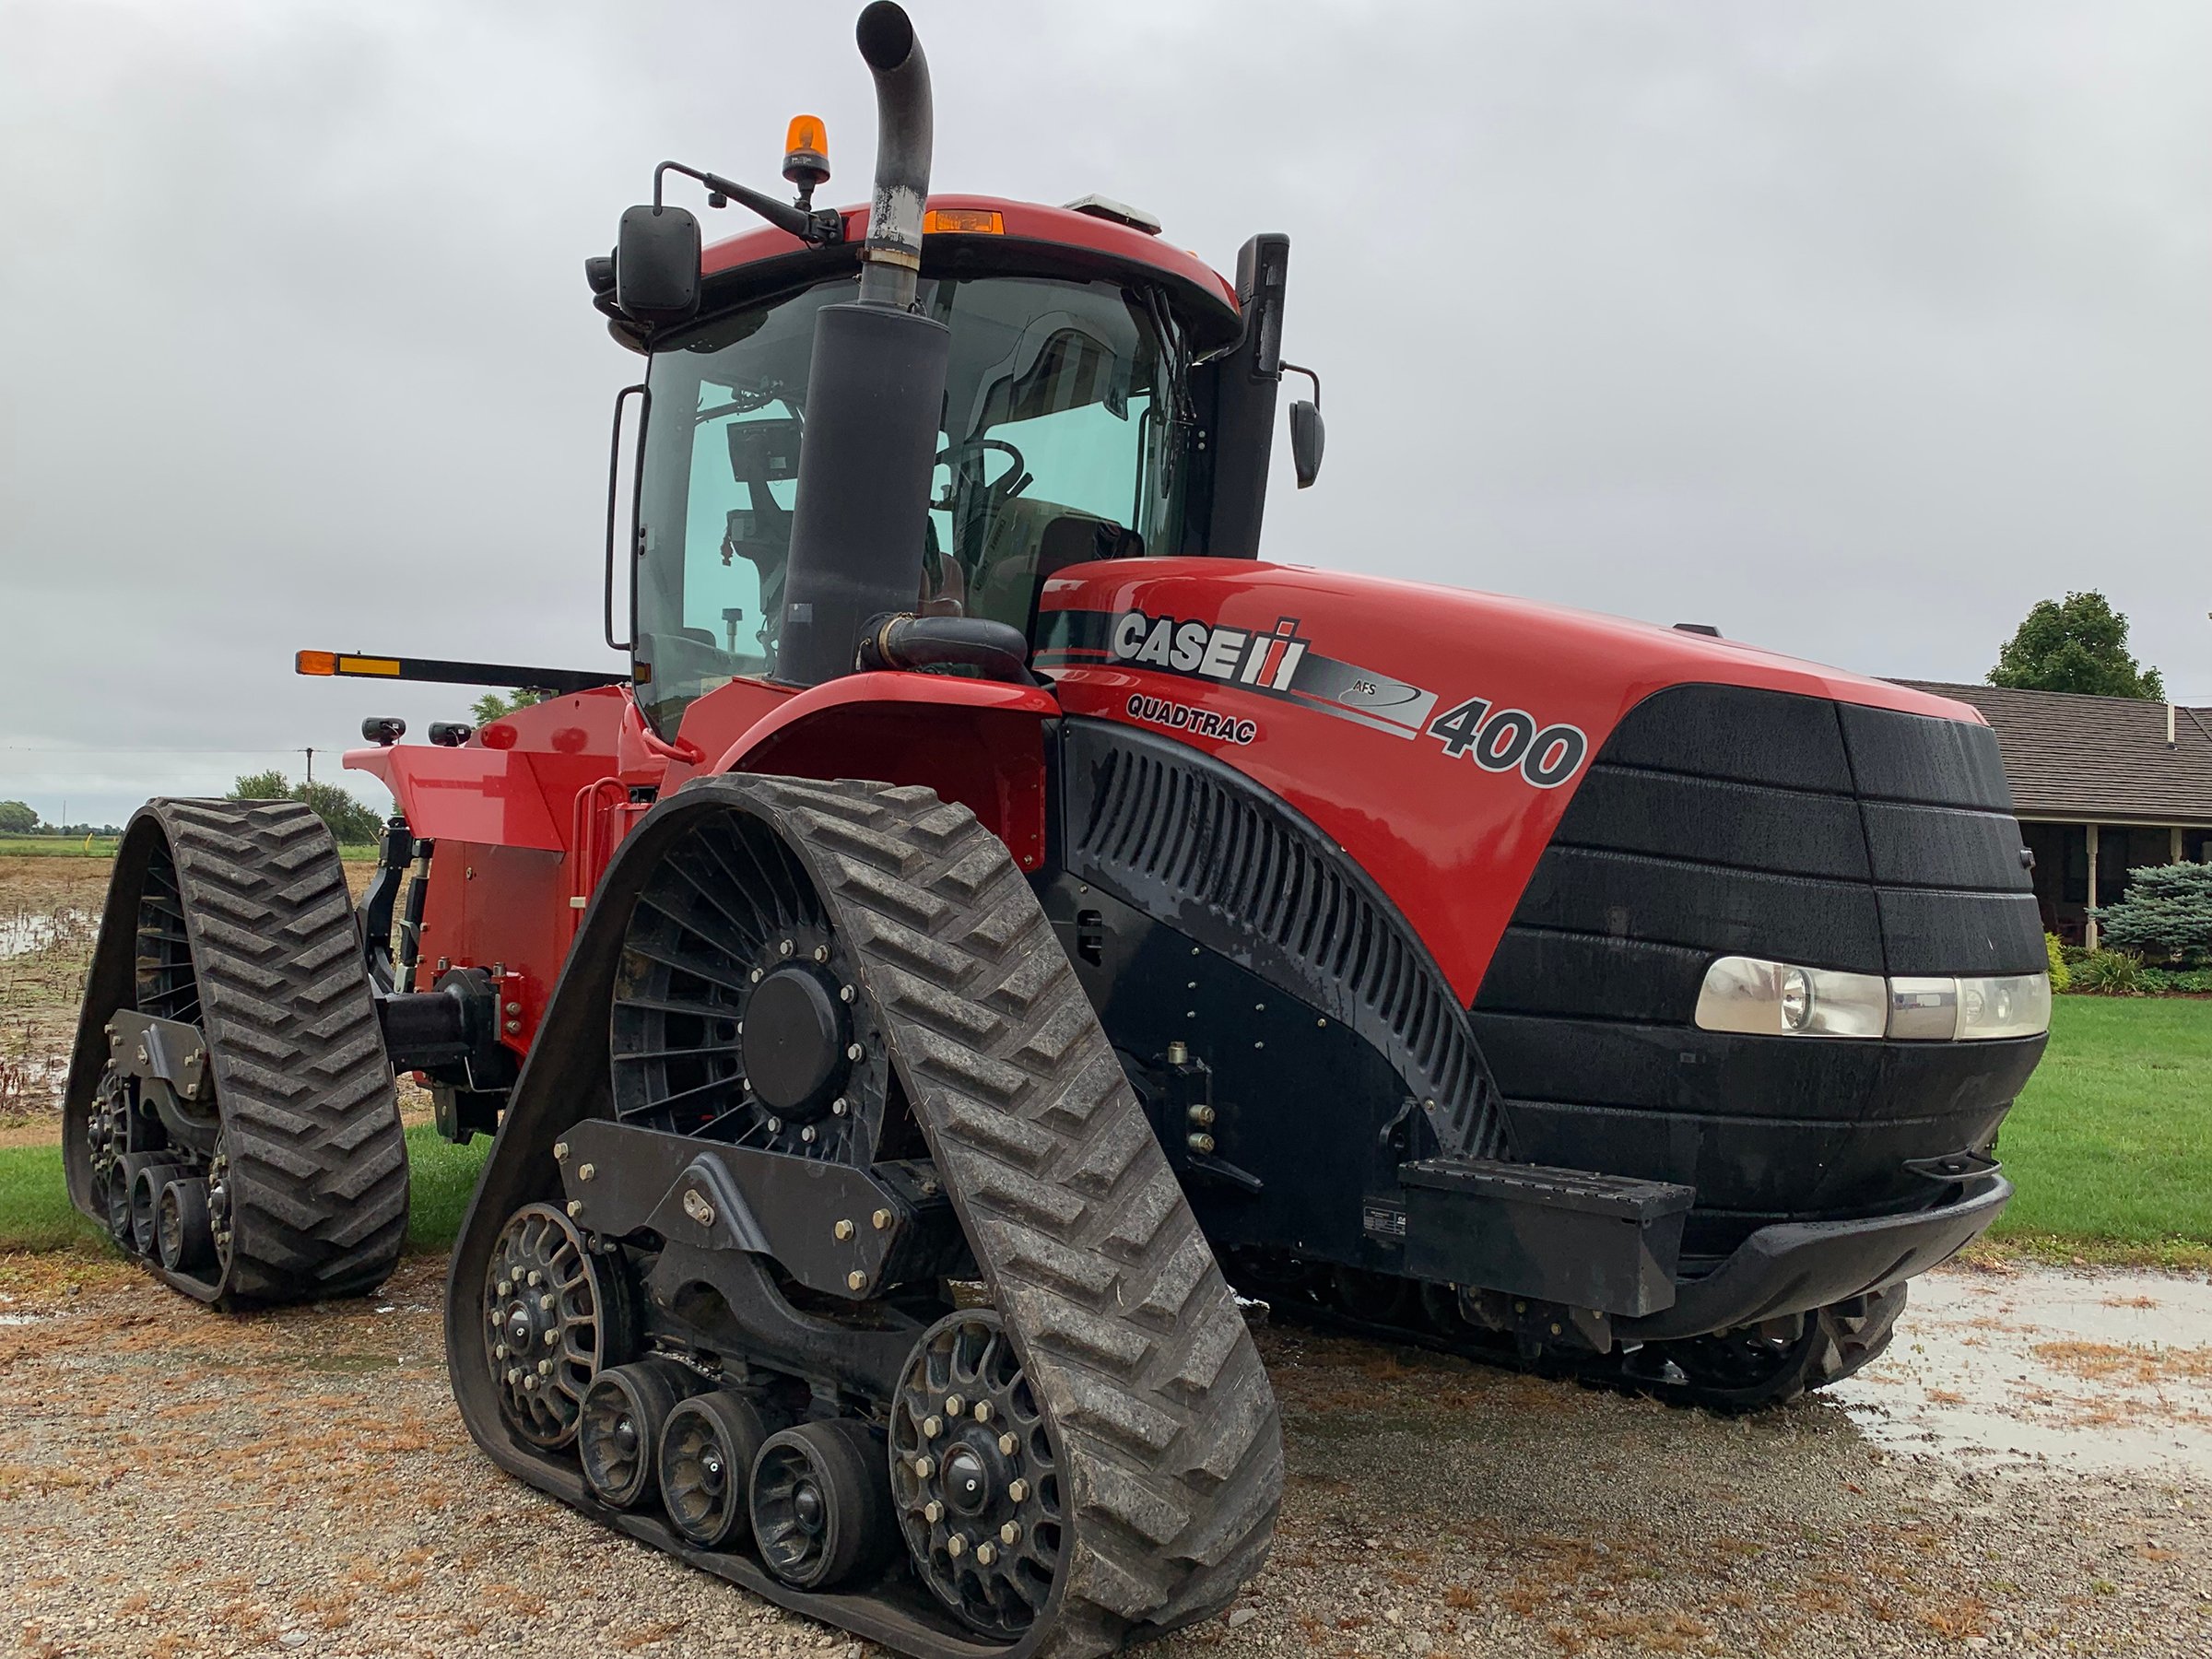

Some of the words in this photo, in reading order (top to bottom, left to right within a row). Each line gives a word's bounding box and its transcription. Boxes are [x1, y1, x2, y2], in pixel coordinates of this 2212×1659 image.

[1114, 612, 1247, 680] CASE
[1352, 679, 1377, 696] AFS
[1126, 693, 1257, 745] QUADTRAC
[1426, 696, 1588, 789] 400
